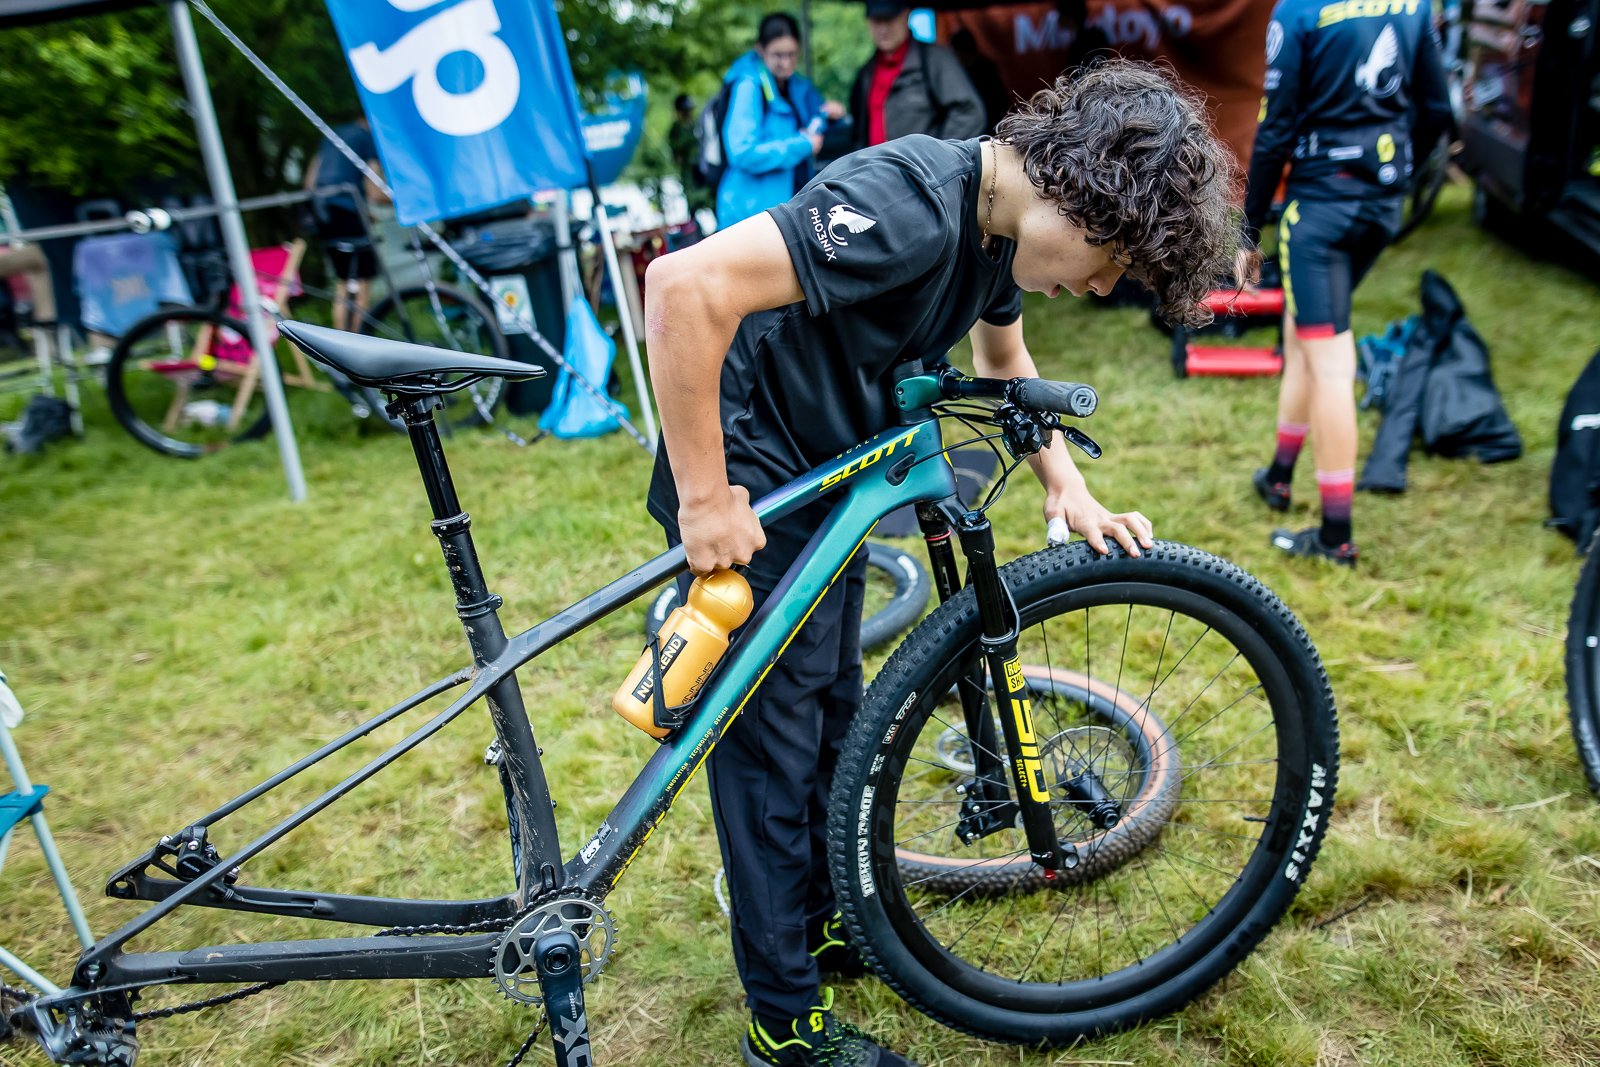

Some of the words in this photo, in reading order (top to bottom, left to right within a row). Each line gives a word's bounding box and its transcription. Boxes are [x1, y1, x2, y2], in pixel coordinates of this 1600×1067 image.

[808, 207, 837, 262] PHOENIX
[819, 429, 920, 492] SCOTT
[636, 637, 683, 700] NUEND
[665, 762, 689, 792] INNOVATION
[688, 727, 713, 760] TECHNOLOGY
[713, 706, 729, 726] DESIGN
[1284, 762, 1327, 882] MAXXIS
